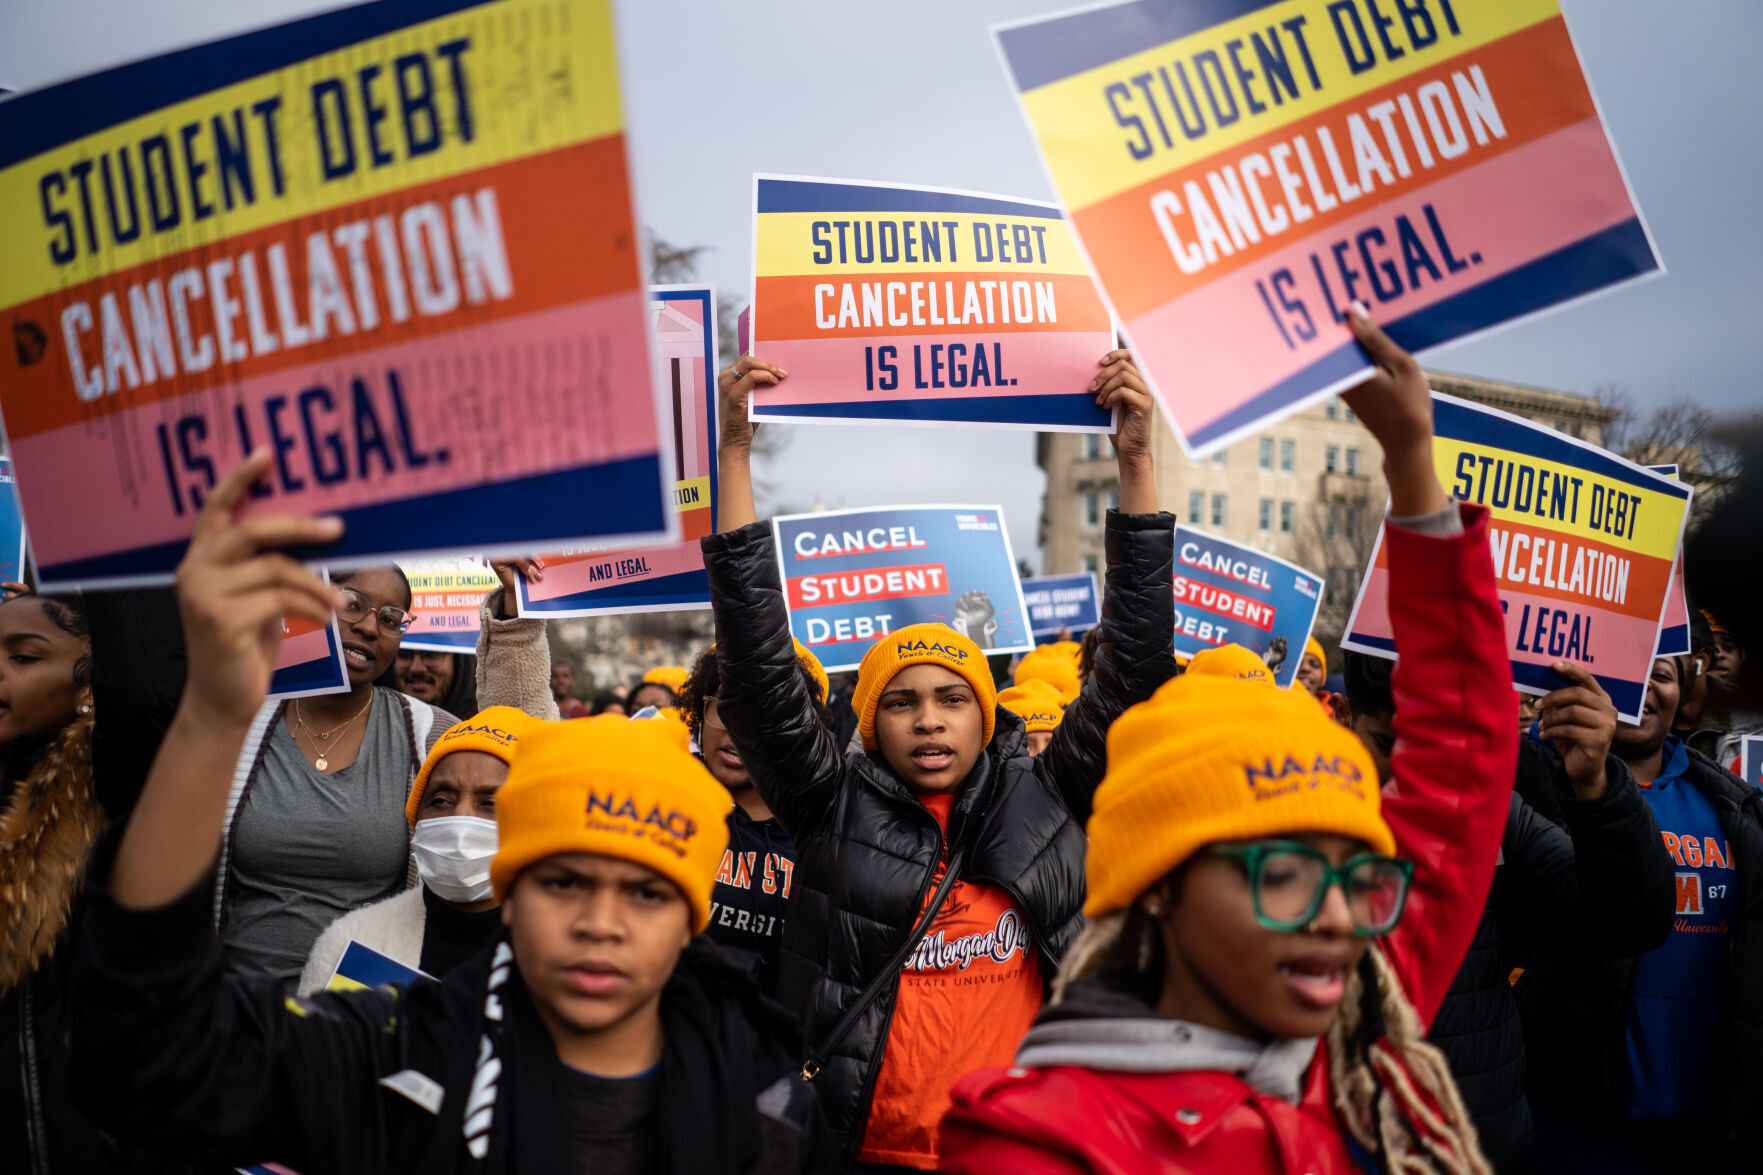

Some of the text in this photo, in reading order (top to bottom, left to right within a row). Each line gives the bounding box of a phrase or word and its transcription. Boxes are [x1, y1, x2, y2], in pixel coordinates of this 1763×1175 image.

[1103, 15, 1322, 161] STUDENT
[38, 37, 475, 266] STUDENT DEBT
[1150, 64, 1507, 275] CANCELLATION
[812, 221, 1047, 264] STUDENT DEBT
[61, 187, 514, 402] CANCELLATION
[1256, 203, 1482, 349] IS LEGAL.
[814, 280, 1057, 329] CANCELLATION
[865, 343, 1018, 391] IS LEGAL.
[157, 369, 452, 516] IS LEGAL.
[1453, 452, 1641, 540] STUDENT DEBT
[794, 526, 925, 556] CANCEL
[589, 557, 652, 582] AND LEGAL.
[800, 568, 942, 602] STUDENT
[1180, 542, 1271, 590] CANCEL
[1489, 527, 1630, 605] NCELLATION
[413, 595, 423, 608] IS
[446, 593, 486, 607] NECESSA
[430, 615, 446, 626] AND
[1173, 578, 1273, 626] STUDENT
[806, 614, 892, 644] DEBT
[898, 640, 968, 660] NAACP
[1516, 604, 1594, 663] LEGAL.
[898, 651, 923, 660] Youth
[937, 653, 965, 666] College
[445, 725, 518, 741] NAACP
[1245, 753, 1362, 787] NAACP
[586, 791, 697, 841] NAACP
[1708, 885, 1727, 899] 67
[908, 978, 946, 987] STATE
